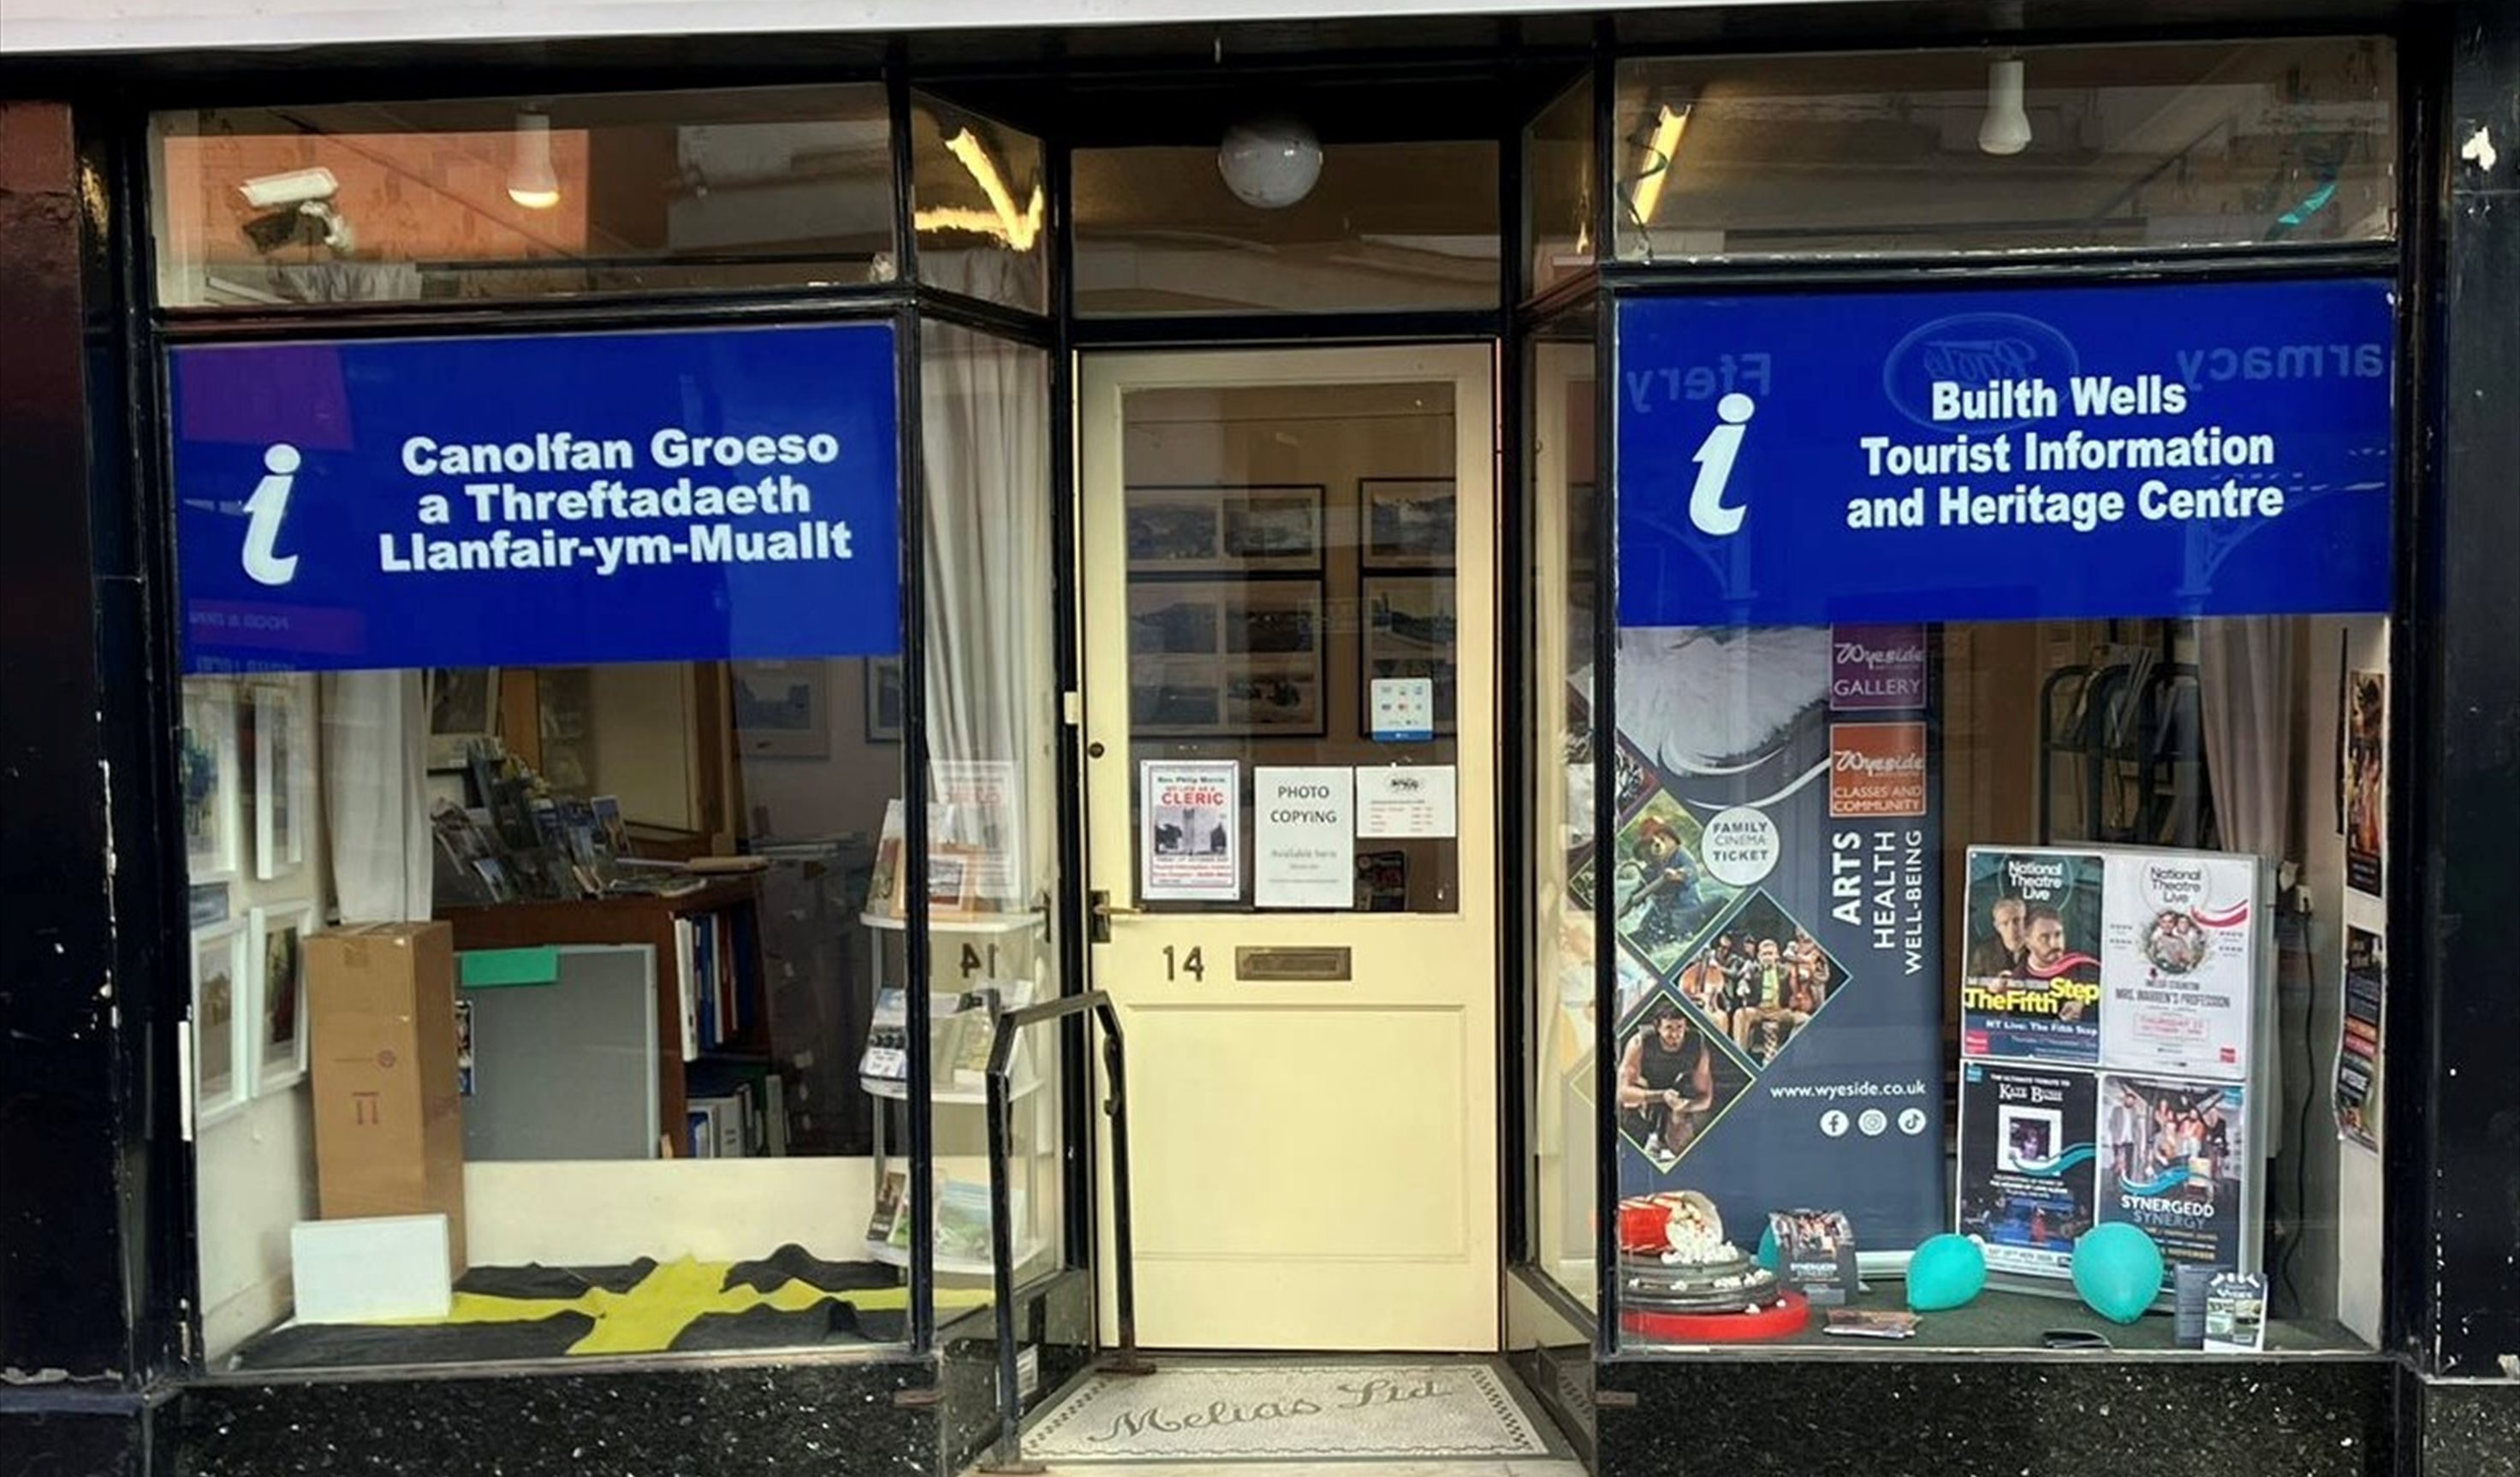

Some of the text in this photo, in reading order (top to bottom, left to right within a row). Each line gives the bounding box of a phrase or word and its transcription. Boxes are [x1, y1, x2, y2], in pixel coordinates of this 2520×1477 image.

[1933, 374, 2187, 420] Builth Wells
[402, 428, 839, 476] Canolfan Groeso
[1860, 426, 2273, 476] Tourist Information
[419, 475, 811, 525] a Threftadaeth
[1846, 479, 2284, 532] and Heritage Centre
[380, 520, 853, 575] Llanfair-ym-Muallt
[1834, 643, 1924, 670] Wyeside
[1834, 679, 1922, 697] GALLERY
[1834, 749, 1924, 777] Wyeside
[1161, 792, 1224, 806] CLERIC
[1277, 786, 1330, 799] PHOTO
[1834, 785, 1923, 798] CLASSES AND
[1834, 798, 1921, 813] COMMUNITY
[1713, 822, 1768, 833] FAMILY
[1714, 835, 1766, 846] CINEMA
[1713, 850, 1768, 862] TICKET
[1832, 831, 1862, 926] ARTS
[2008, 860, 2063, 876] National
[2149, 866, 2202, 881] National
[1873, 831, 1896, 949] HEALTH
[2009, 874, 2063, 889] Theatre
[2151, 879, 2202, 893] Theatre
[1905, 830, 1923, 976] WELL-BEING
[2022, 886, 2050, 901] Live
[2162, 890, 2189, 904] Live
[1162, 945, 1204, 982] 14
[2049, 977, 2101, 1005] Step
[1769, 1079, 1926, 1100] www.wyeside.co.uk
[2120, 1195, 2214, 1218] SYNERGEDD
[2133, 1210, 2206, 1230] SYNERGY
[1088, 1379, 1453, 1443] Melias Ltd
